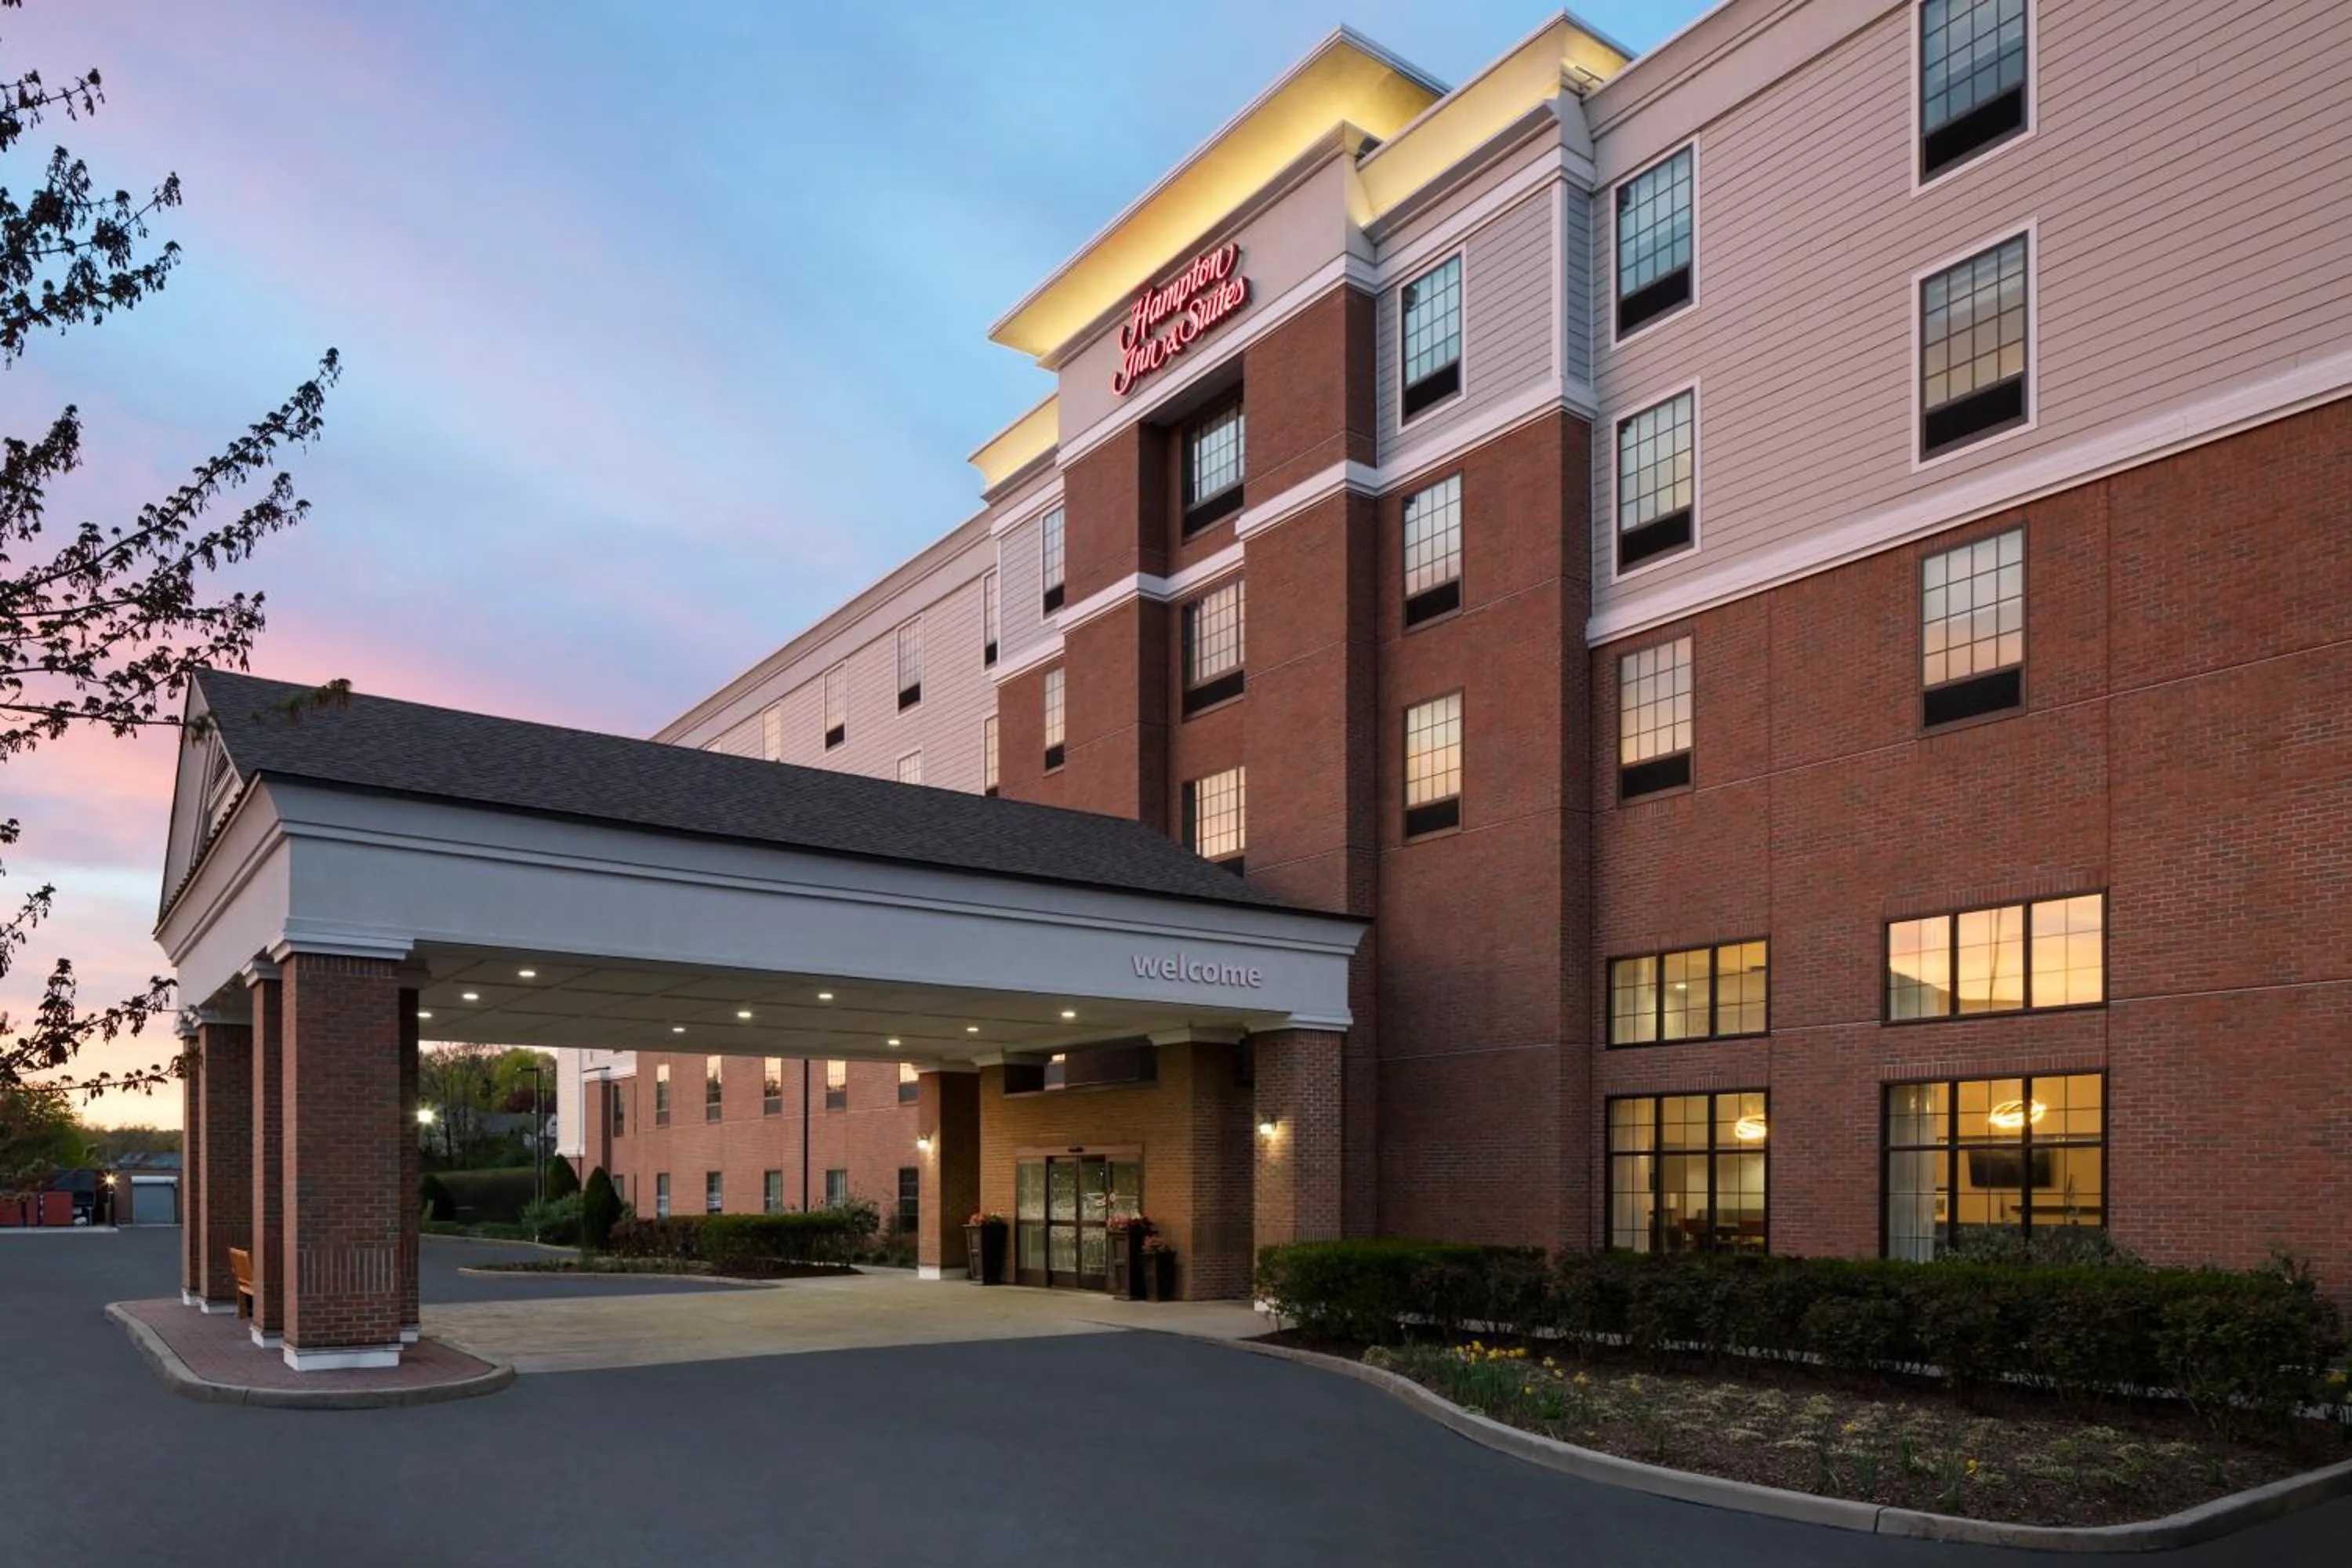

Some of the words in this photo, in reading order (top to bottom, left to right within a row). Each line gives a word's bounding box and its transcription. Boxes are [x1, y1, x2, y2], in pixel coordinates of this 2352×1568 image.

[1112, 339, 1167, 395] Inn
[1166, 326, 1182, 354] &
[1179, 276, 1250, 343] Suites
[1120, 243, 1239, 353] Hampton
[1131, 953, 1262, 988] welcome
